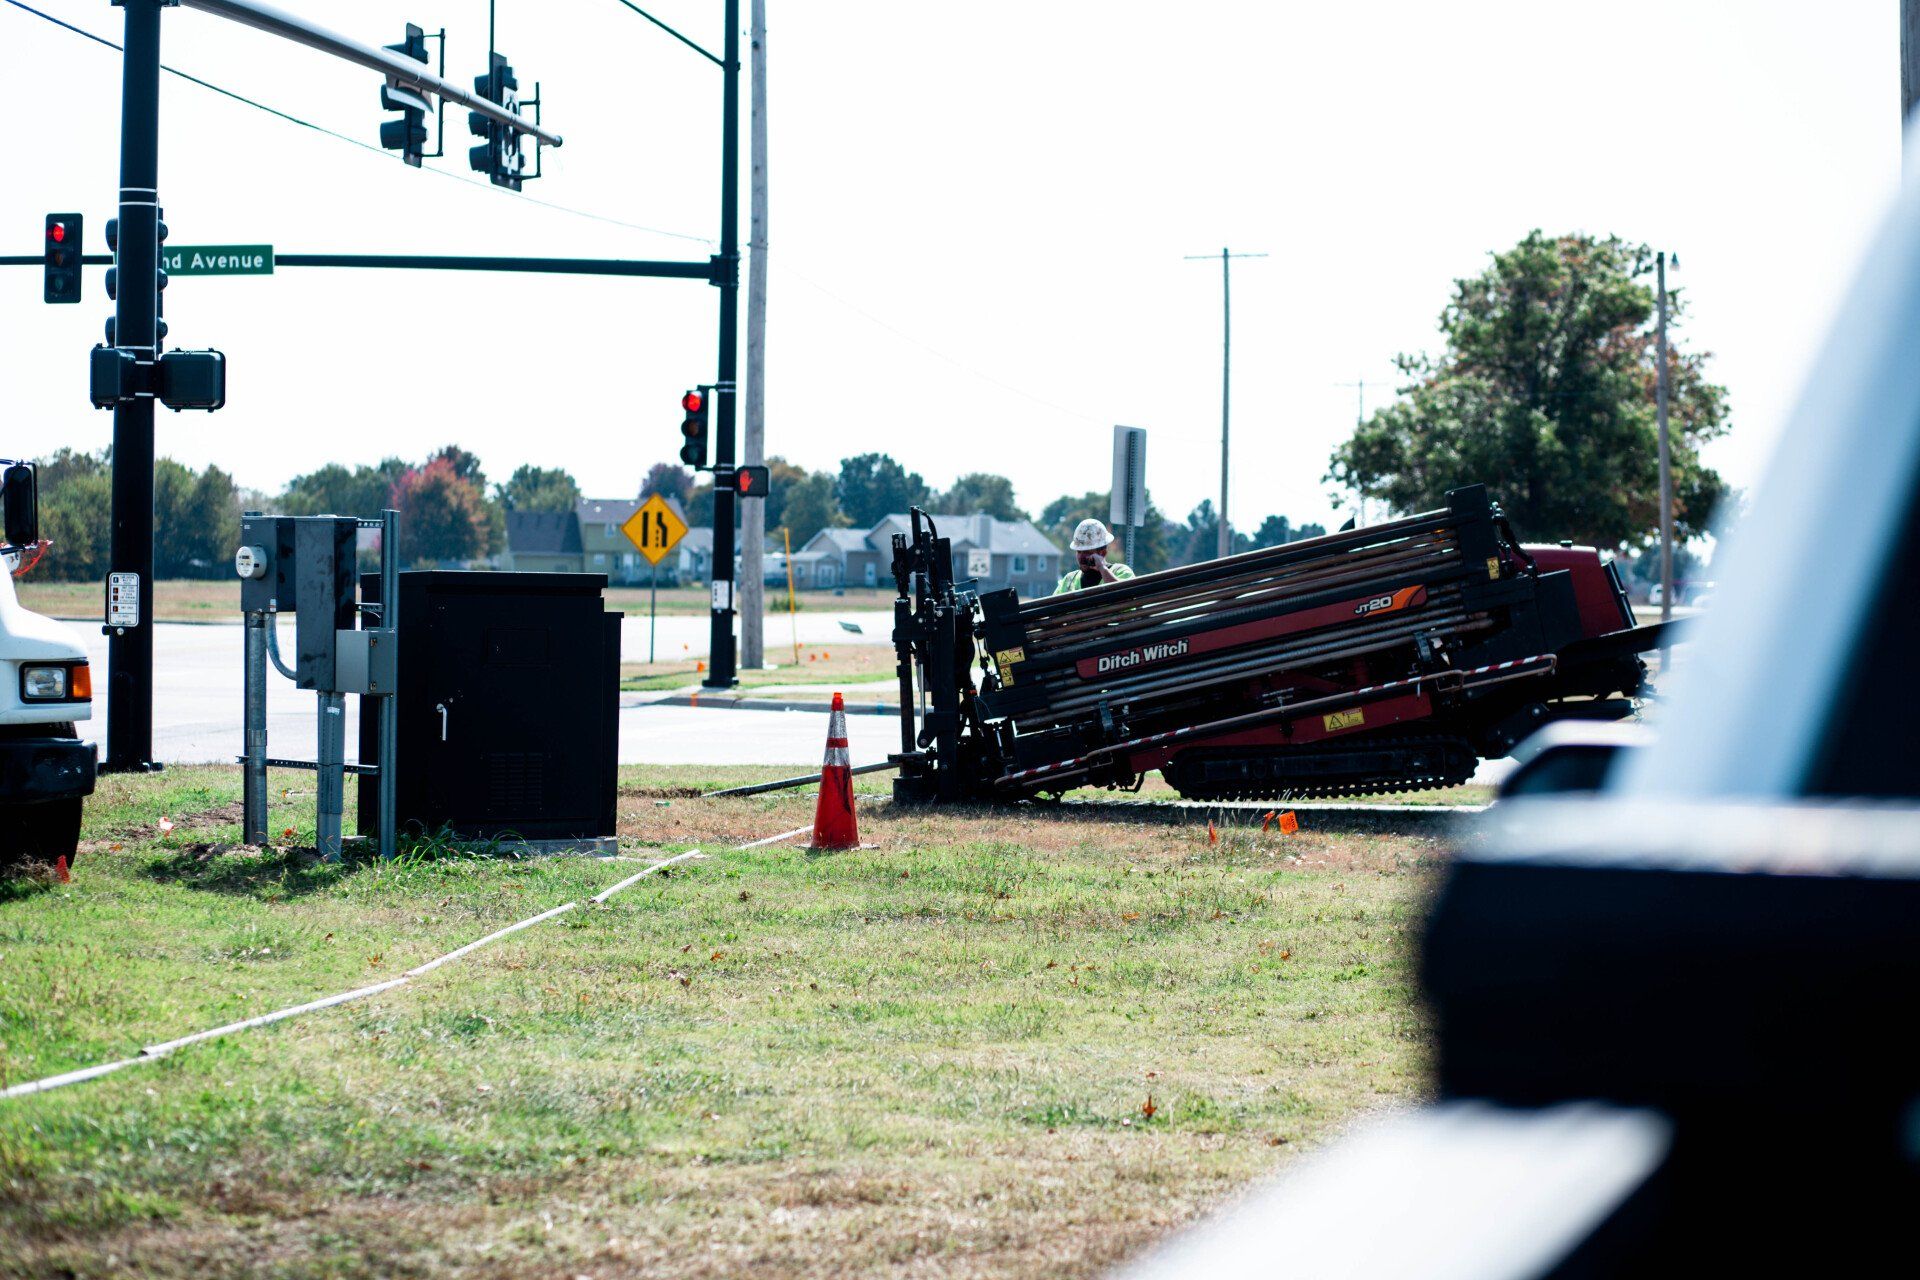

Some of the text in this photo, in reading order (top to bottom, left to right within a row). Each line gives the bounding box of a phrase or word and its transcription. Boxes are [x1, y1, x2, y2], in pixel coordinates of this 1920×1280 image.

[190, 252, 263, 269] Avenue
[1354, 596, 1393, 614] JT20
[1098, 640, 1188, 672] Ditch Witch
